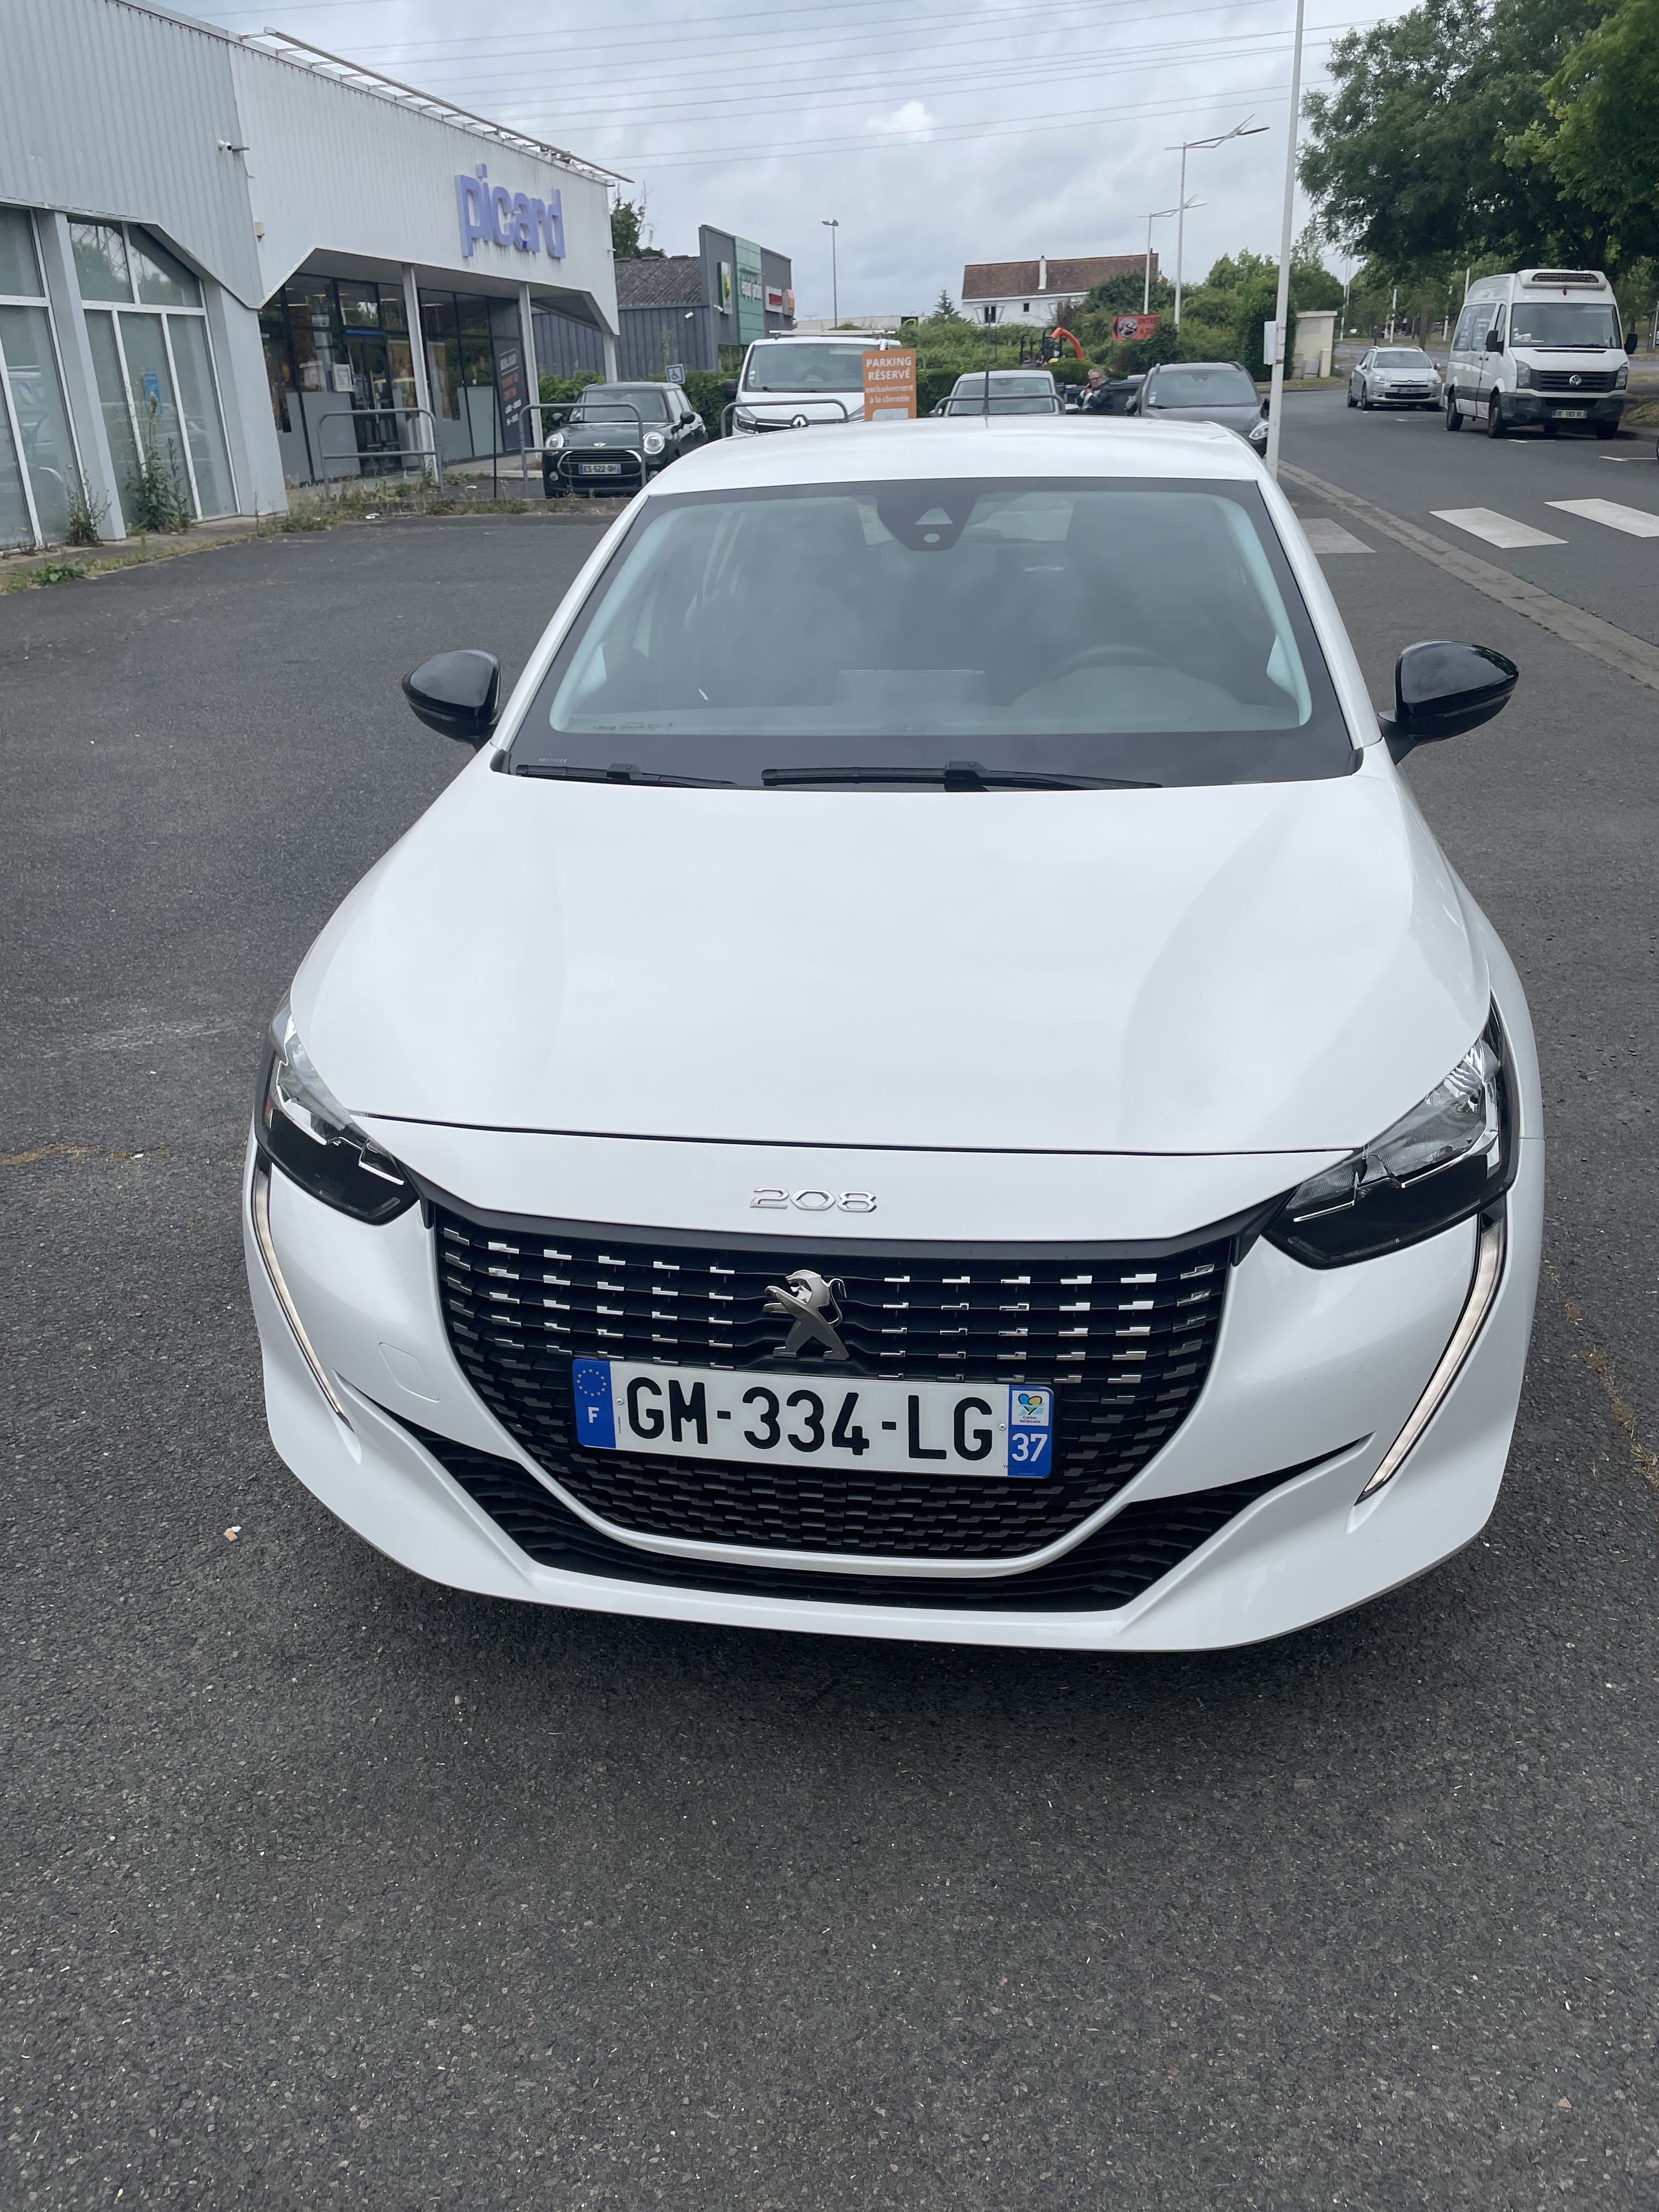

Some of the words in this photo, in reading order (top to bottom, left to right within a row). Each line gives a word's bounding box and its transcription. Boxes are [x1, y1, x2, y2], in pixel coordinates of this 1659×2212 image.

[454, 163, 566, 259] picard
[867, 357, 911, 368] PARKING
[868, 367, 911, 380] RÉSERVÉ
[750, 1187, 877, 1212] 208
[588, 1406, 600, 1423] F
[627, 1377, 992, 1460] GM-334-LG
[1012, 1433, 1048, 1462] 37
